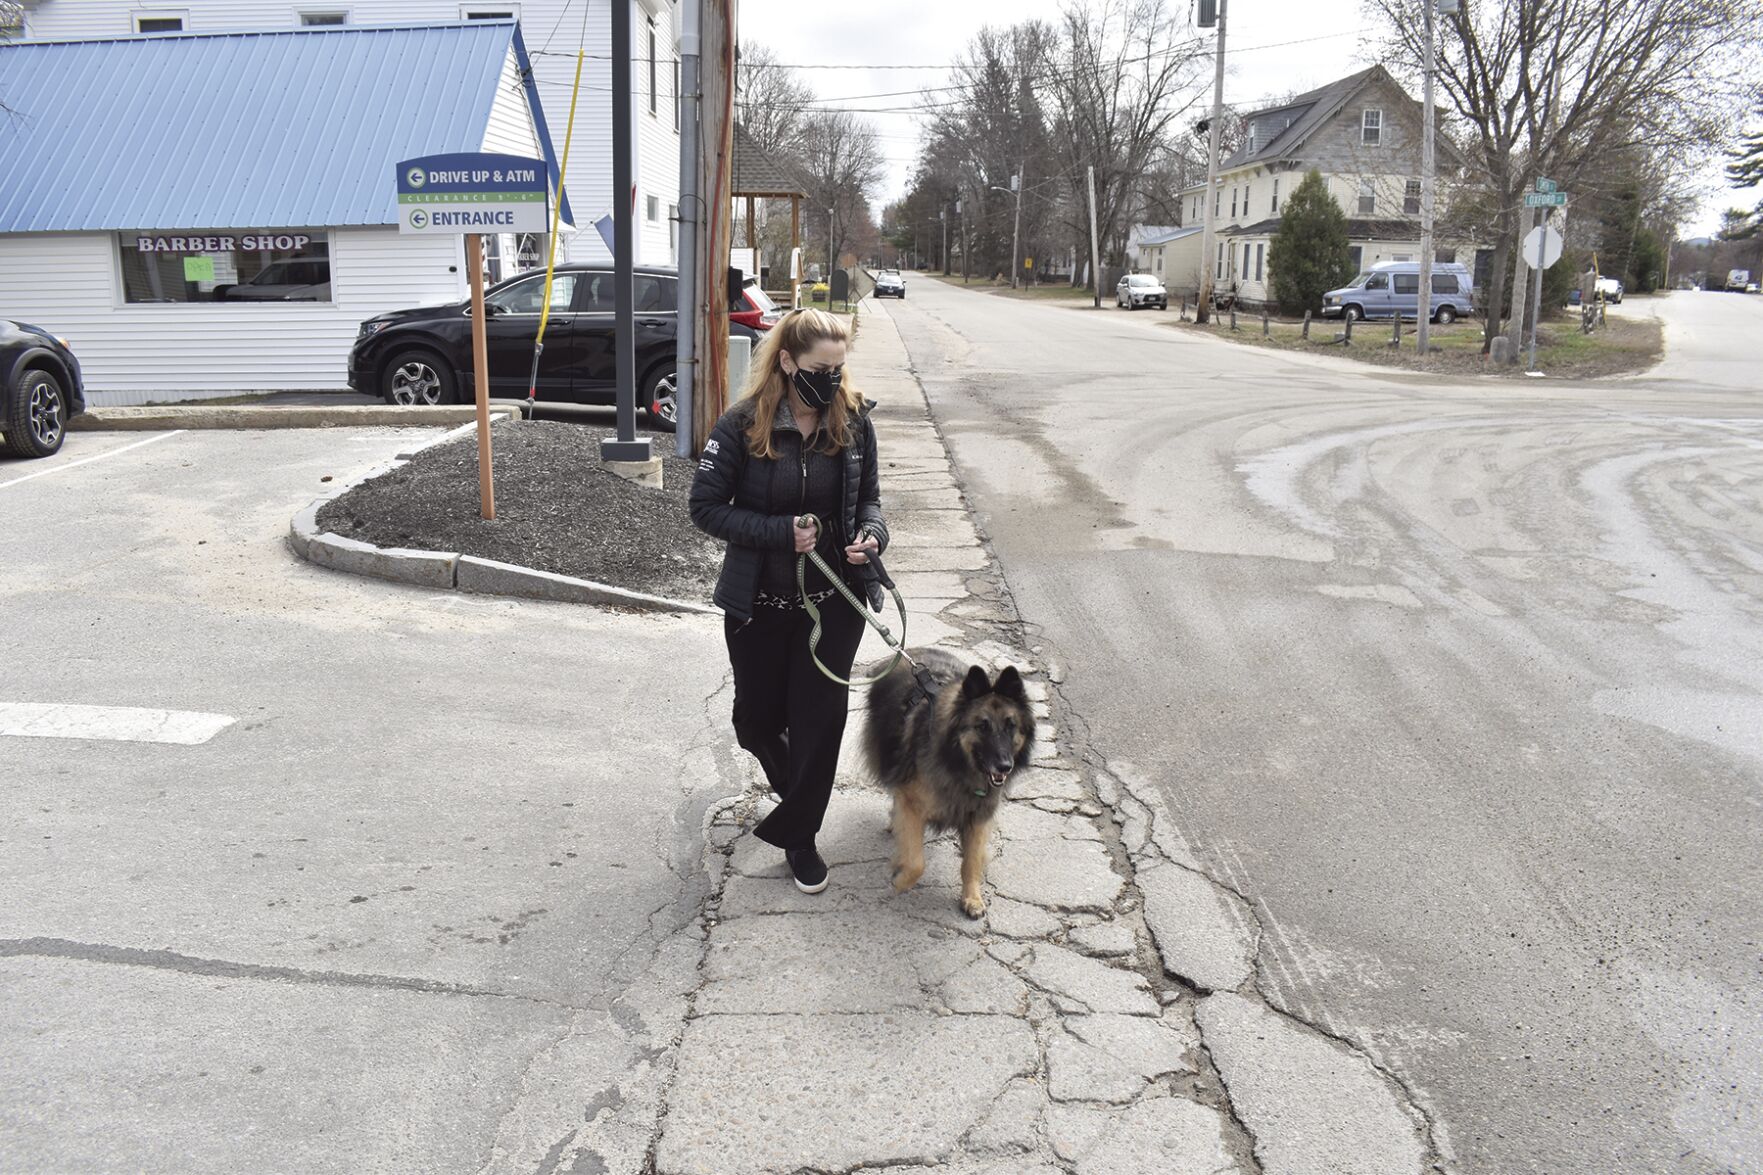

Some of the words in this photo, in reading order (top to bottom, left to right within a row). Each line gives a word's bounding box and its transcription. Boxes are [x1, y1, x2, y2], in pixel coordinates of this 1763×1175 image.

[429, 170, 469, 184] DRIVE
[472, 170, 490, 183] UP
[492, 170, 503, 182] &
[506, 170, 535, 182] ATM
[407, 193, 487, 202] CLEARANCE
[1529, 195, 1556, 205] OXFORD
[432, 211, 514, 225] ENTRANCE
[137, 236, 236, 252] BARBER
[242, 235, 310, 251] SHOP
